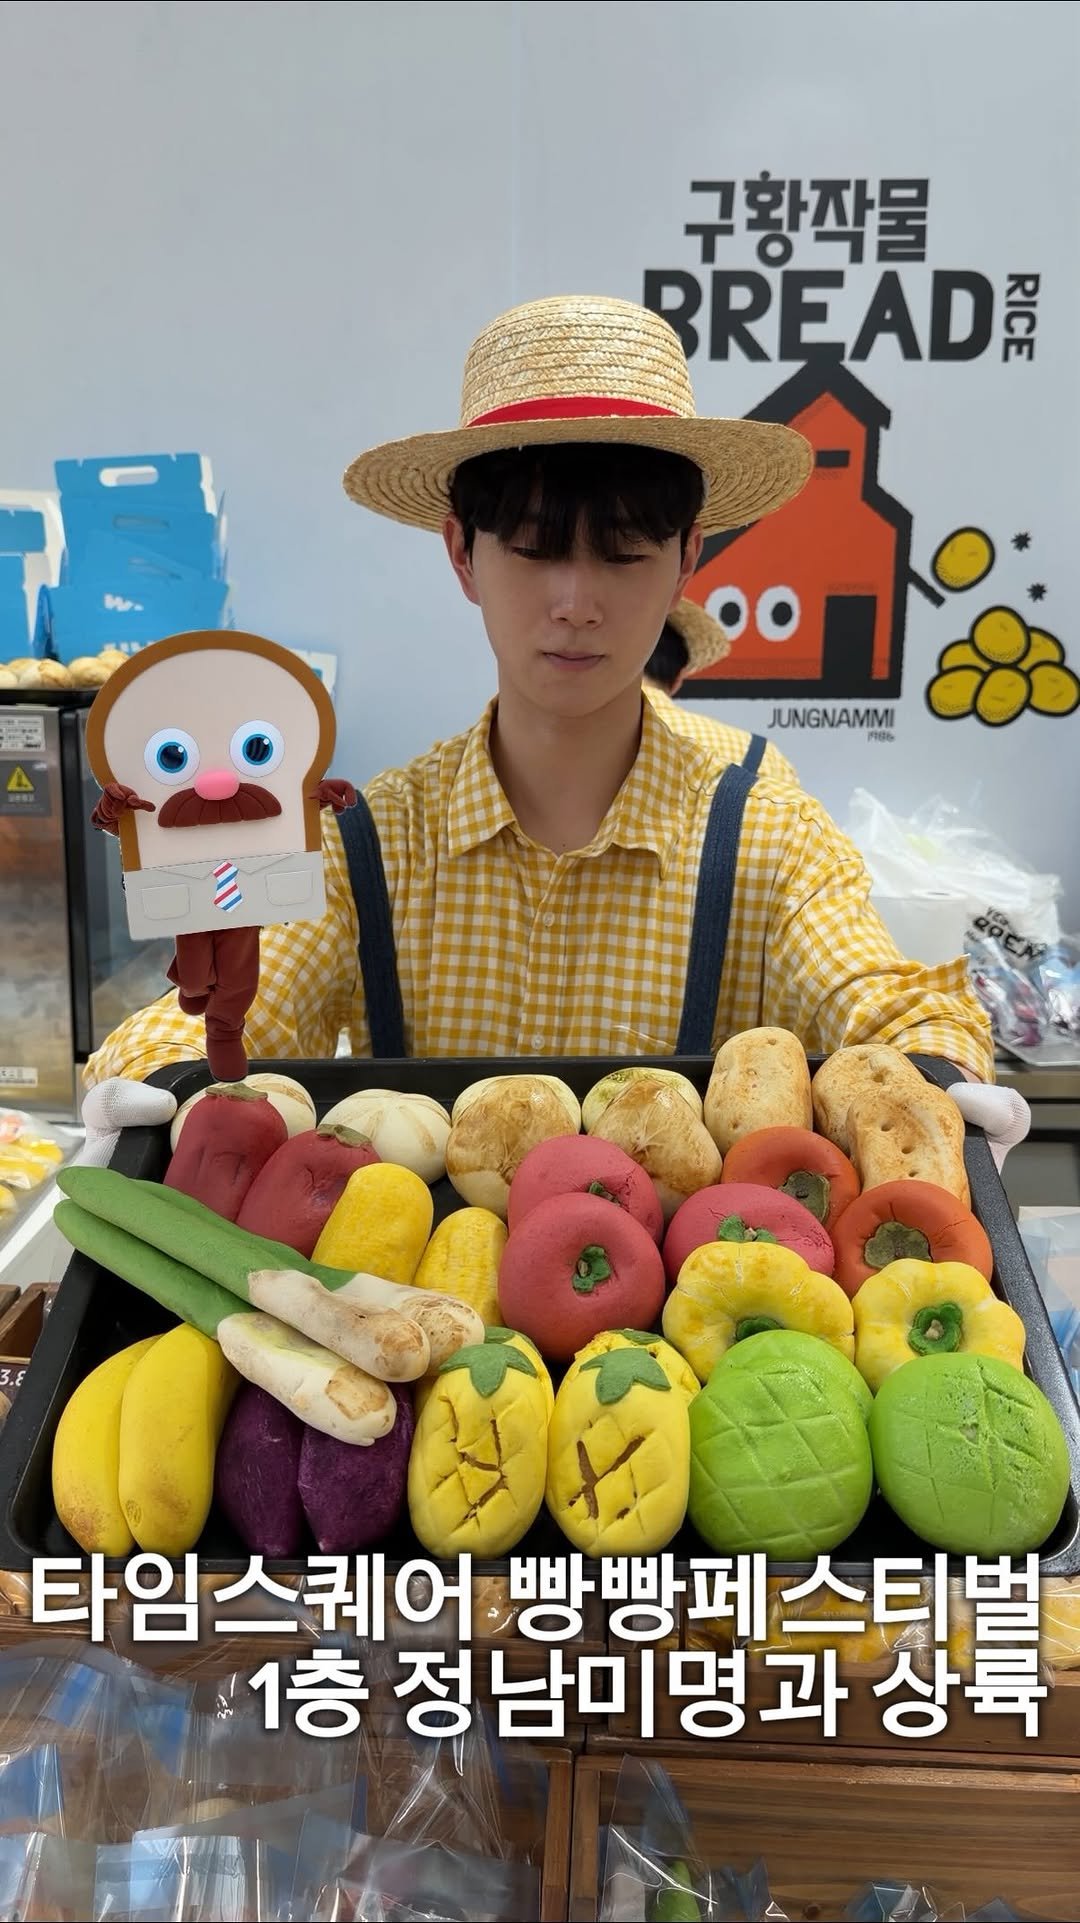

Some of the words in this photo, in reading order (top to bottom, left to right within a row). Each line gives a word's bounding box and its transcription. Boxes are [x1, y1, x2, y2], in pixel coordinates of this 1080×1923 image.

[684, 169, 930, 267] 구황작물
[643, 269, 995, 361] BREAD
[1003, 273, 1041, 362] RICE
[767, 708, 895, 729] JUNGNAMMI
